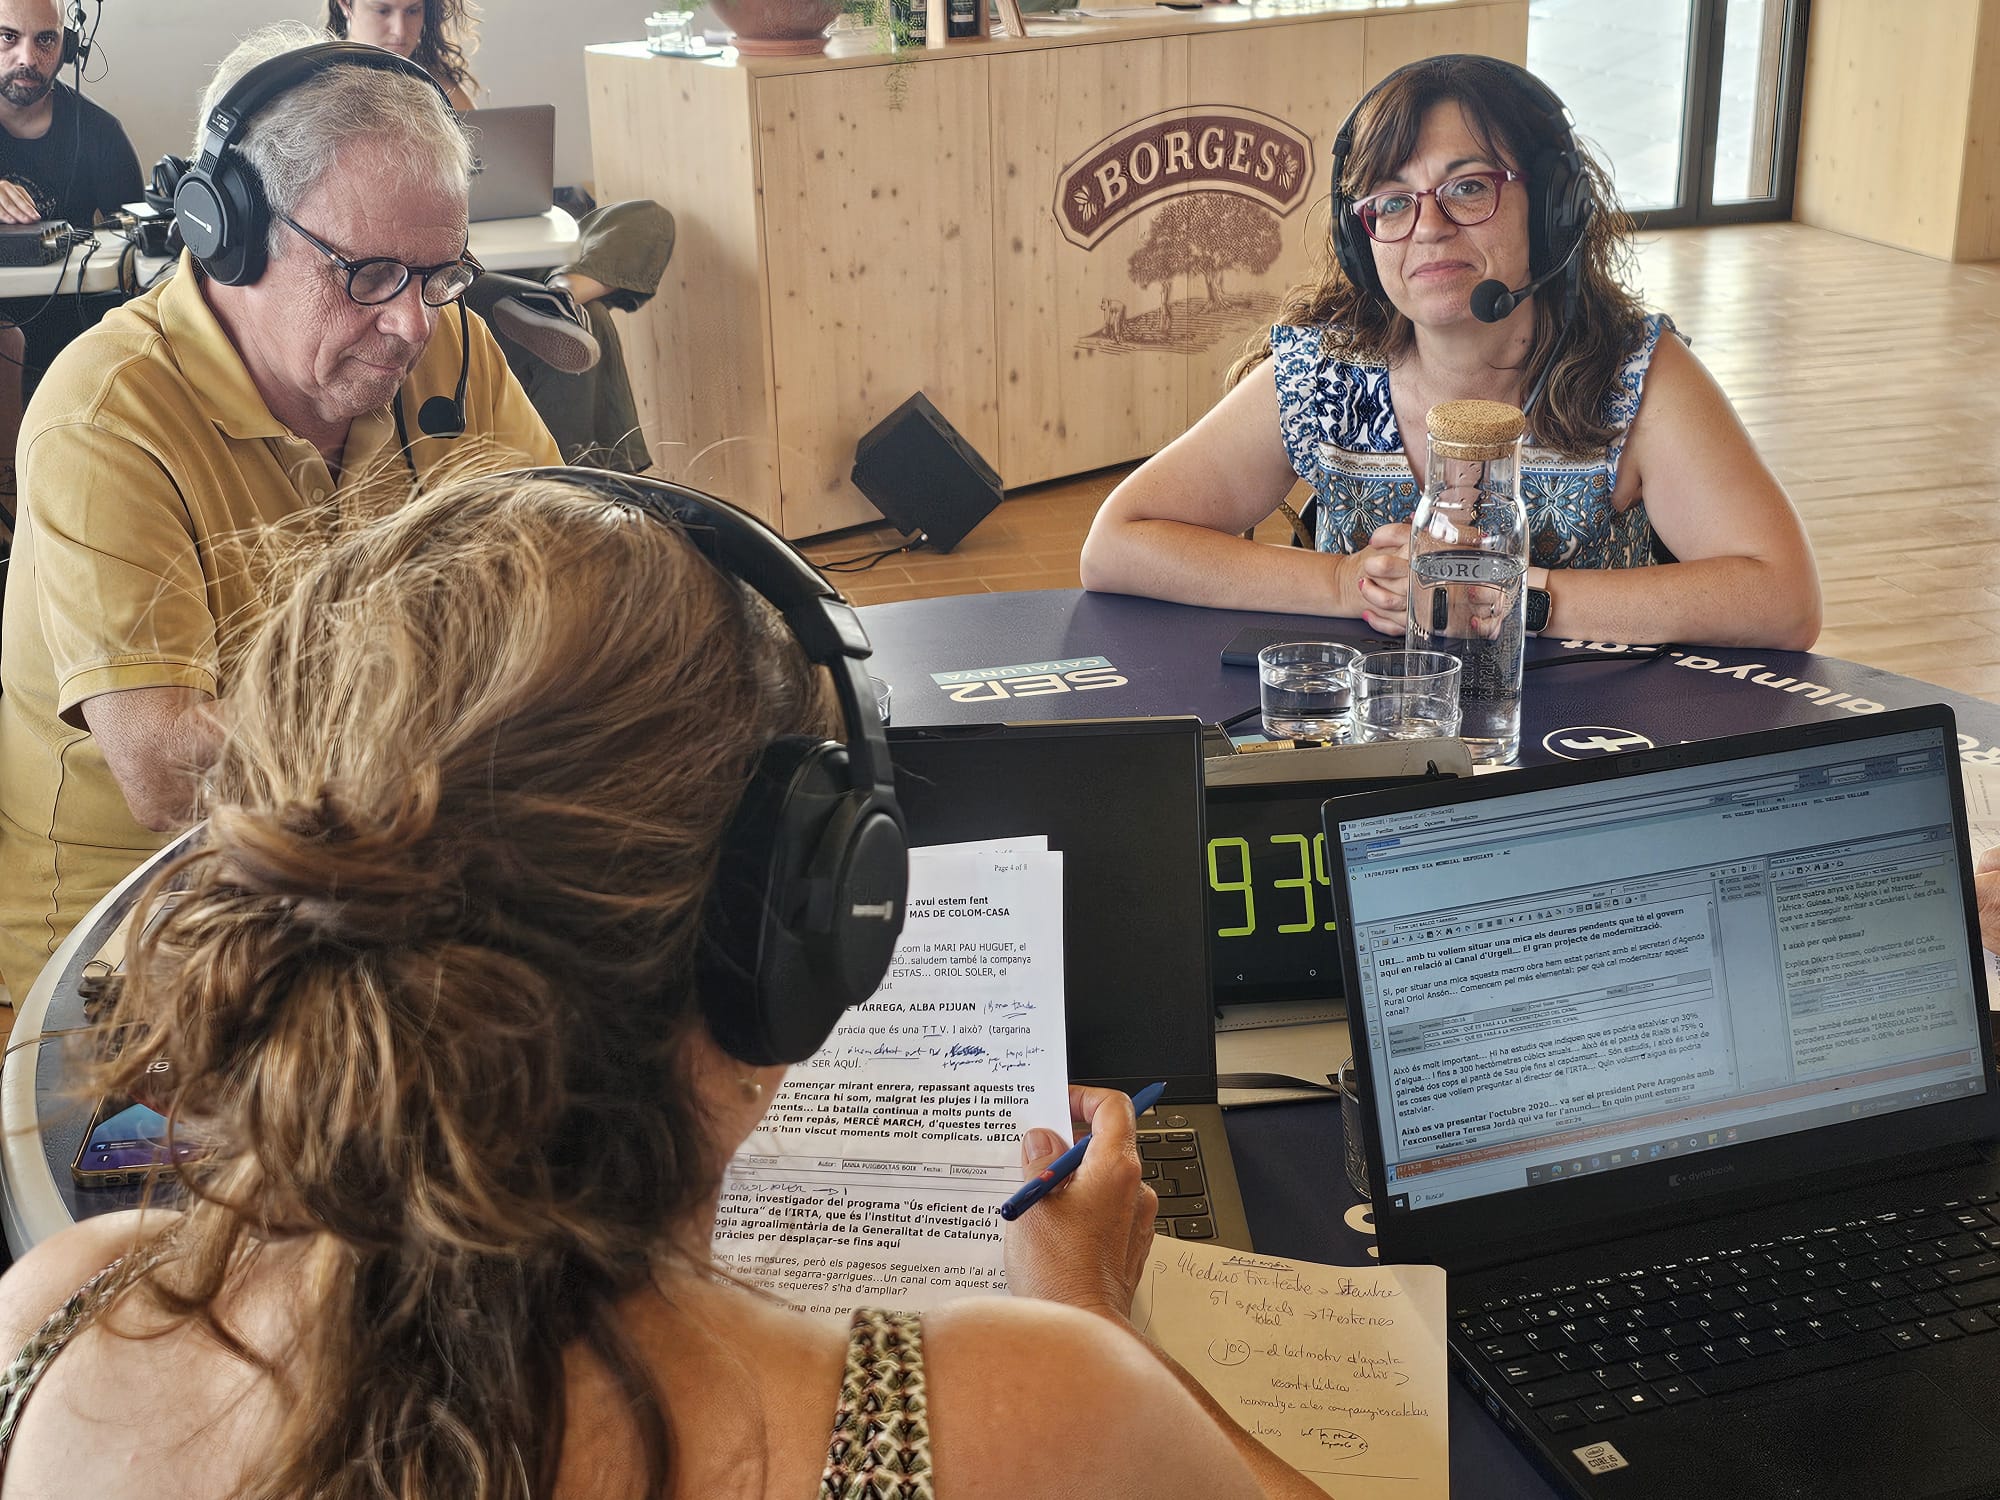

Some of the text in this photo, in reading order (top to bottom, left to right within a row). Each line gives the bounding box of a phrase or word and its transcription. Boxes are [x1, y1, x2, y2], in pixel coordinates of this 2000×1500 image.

[1093, 127, 1280, 209] BORGES
[943, 658, 1100, 681] CATALUNYA
[940, 666, 1128, 703] SER
[915, 897, 934, 905] avui
[969, 896, 988, 904] fent
[1406, 953, 1424, 961] amb
[1438, 945, 1465, 956] volíem
[1467, 940, 1493, 950] situar
[1512, 934, 1532, 943] mica
[1534, 931, 1546, 939] els
[1548, 926, 1576, 936] deures
[1578, 919, 1617, 932] pendents
[1618, 917, 1634, 925] que
[1655, 909, 1683, 919] govern
[979, 944, 1016, 952] HUGUET,
[1380, 967, 1398, 978] aquí
[1413, 960, 1442, 970] relació
[1454, 954, 1477, 963] Canal
[1532, 942, 1551, 951] gran
[1554, 934, 1587, 947] projecte
[1602, 921, 1661, 937] modernització.
[950, 955, 976, 963] també
[964, 968, 995, 977] SOLER,
[856, 1002, 905, 1012] TÀRREGA,
[837, 1025, 865, 1035] gràcia
[868, 1027, 885, 1035] que
[888, 1025, 898, 1033] és
[959, 1025, 982, 1033] això?
[988, 1025, 1030, 1034] (targarina
[833, 1058, 860, 1068] AQUÍ.
[784, 1082, 834, 1090] començar
[838, 1081, 873, 1089] mirant
[918, 1083, 969, 1092] repassant
[973, 1084, 1013, 1093] aquests
[794, 1092, 829, 1100] Encara
[875, 1094, 916, 1103] malgrat
[938, 1095, 970, 1105] plujes
[993, 1096, 1028, 1104] millora
[1401, 1126, 1419, 1135] Això
[1446, 1113, 1486, 1128] presentar
[1489, 1105, 1525, 1118] l'octubre
[1596, 1084, 1635, 1098] president
[1636, 1080, 1655, 1089] Pere
[1657, 1072, 1694, 1086] Aragonès
[1696, 1068, 1714, 1077] amb
[832, 1104, 868, 1112] batalla
[872, 1106, 918, 1114] continua
[932, 1107, 961, 1115] molts
[965, 1109, 995, 1118] punts
[998, 1109, 1011, 1117] de
[782, 1114, 802, 1122] fem
[806, 1114, 839, 1125] repàs,
[843, 1114, 879, 1124] MERCÈ
[883, 1118, 924, 1127] MARCH,
[928, 1119, 980, 1130] d'questes
[772, 1125, 800, 1133] s'han
[804, 1126, 836, 1134] viscut
[840, 1128, 889, 1136] moments
[921, 1131, 982, 1142] complicats.
[755, 1194, 824, 1206] investigador
[827, 1197, 843, 1205] del
[847, 1200, 899, 1210] programa
[926, 1203, 967, 1212] eficient
[971, 1205, 984, 1213] de
[768, 1207, 781, 1215] de
[784, 1208, 821, 1218] l'IRTA,
[825, 1212, 845, 1220] que
[849, 1211, 861, 1219] és
[864, 1212, 912, 1222] l'institut
[914, 1214, 991, 1227] d'investigació
[740, 1218, 1002, 1241] agroalimentària de la Generalitat de Catalunya,
[715, 1229, 900, 1248] gràcies per desplaçar-se fins aquí
